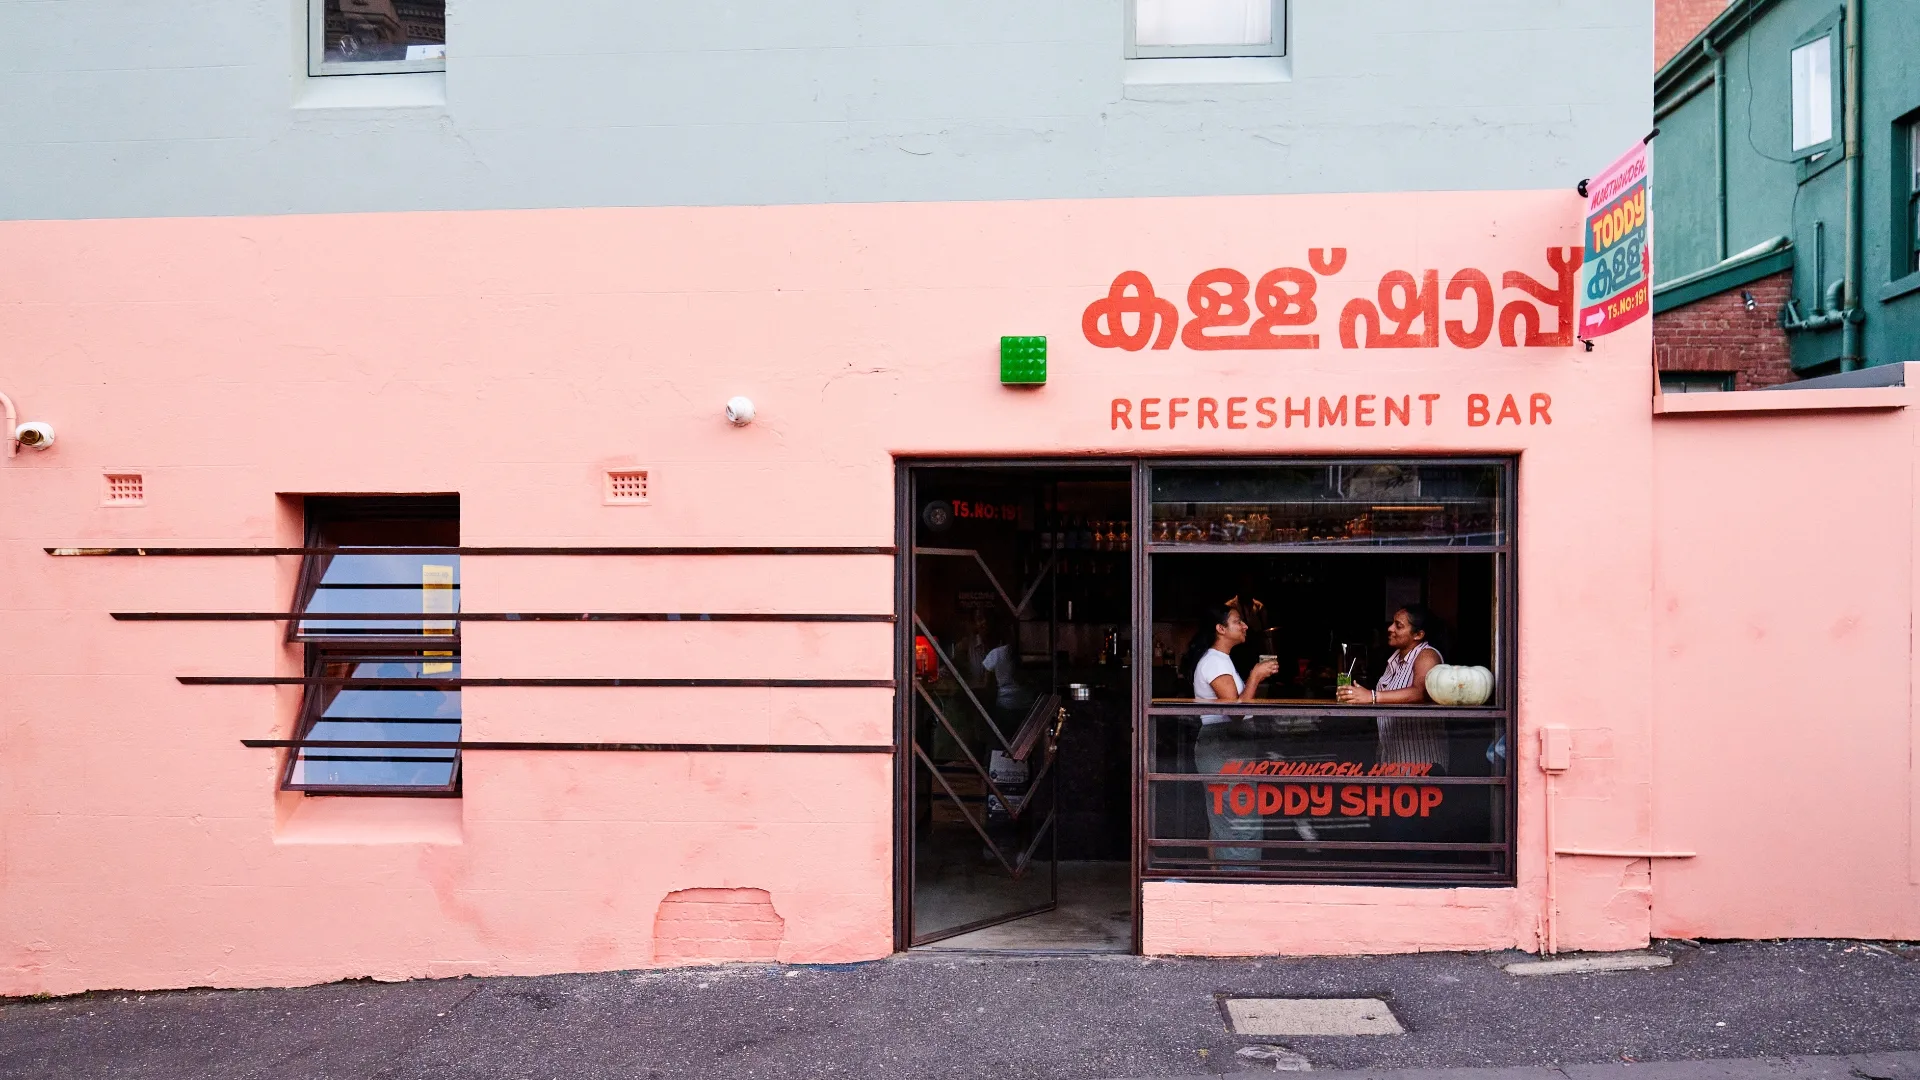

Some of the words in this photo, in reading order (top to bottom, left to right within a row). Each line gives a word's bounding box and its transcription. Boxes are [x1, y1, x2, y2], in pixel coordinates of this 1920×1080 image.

[1591, 186, 1645, 253] TODDY
[1081, 247, 1347, 352] കള്ള്
[1110, 393, 1440, 430] REFRESHMENT
[1466, 392, 1553, 427] BAR
[1207, 783, 1333, 816] TODDY
[1340, 784, 1444, 817] SHOP
